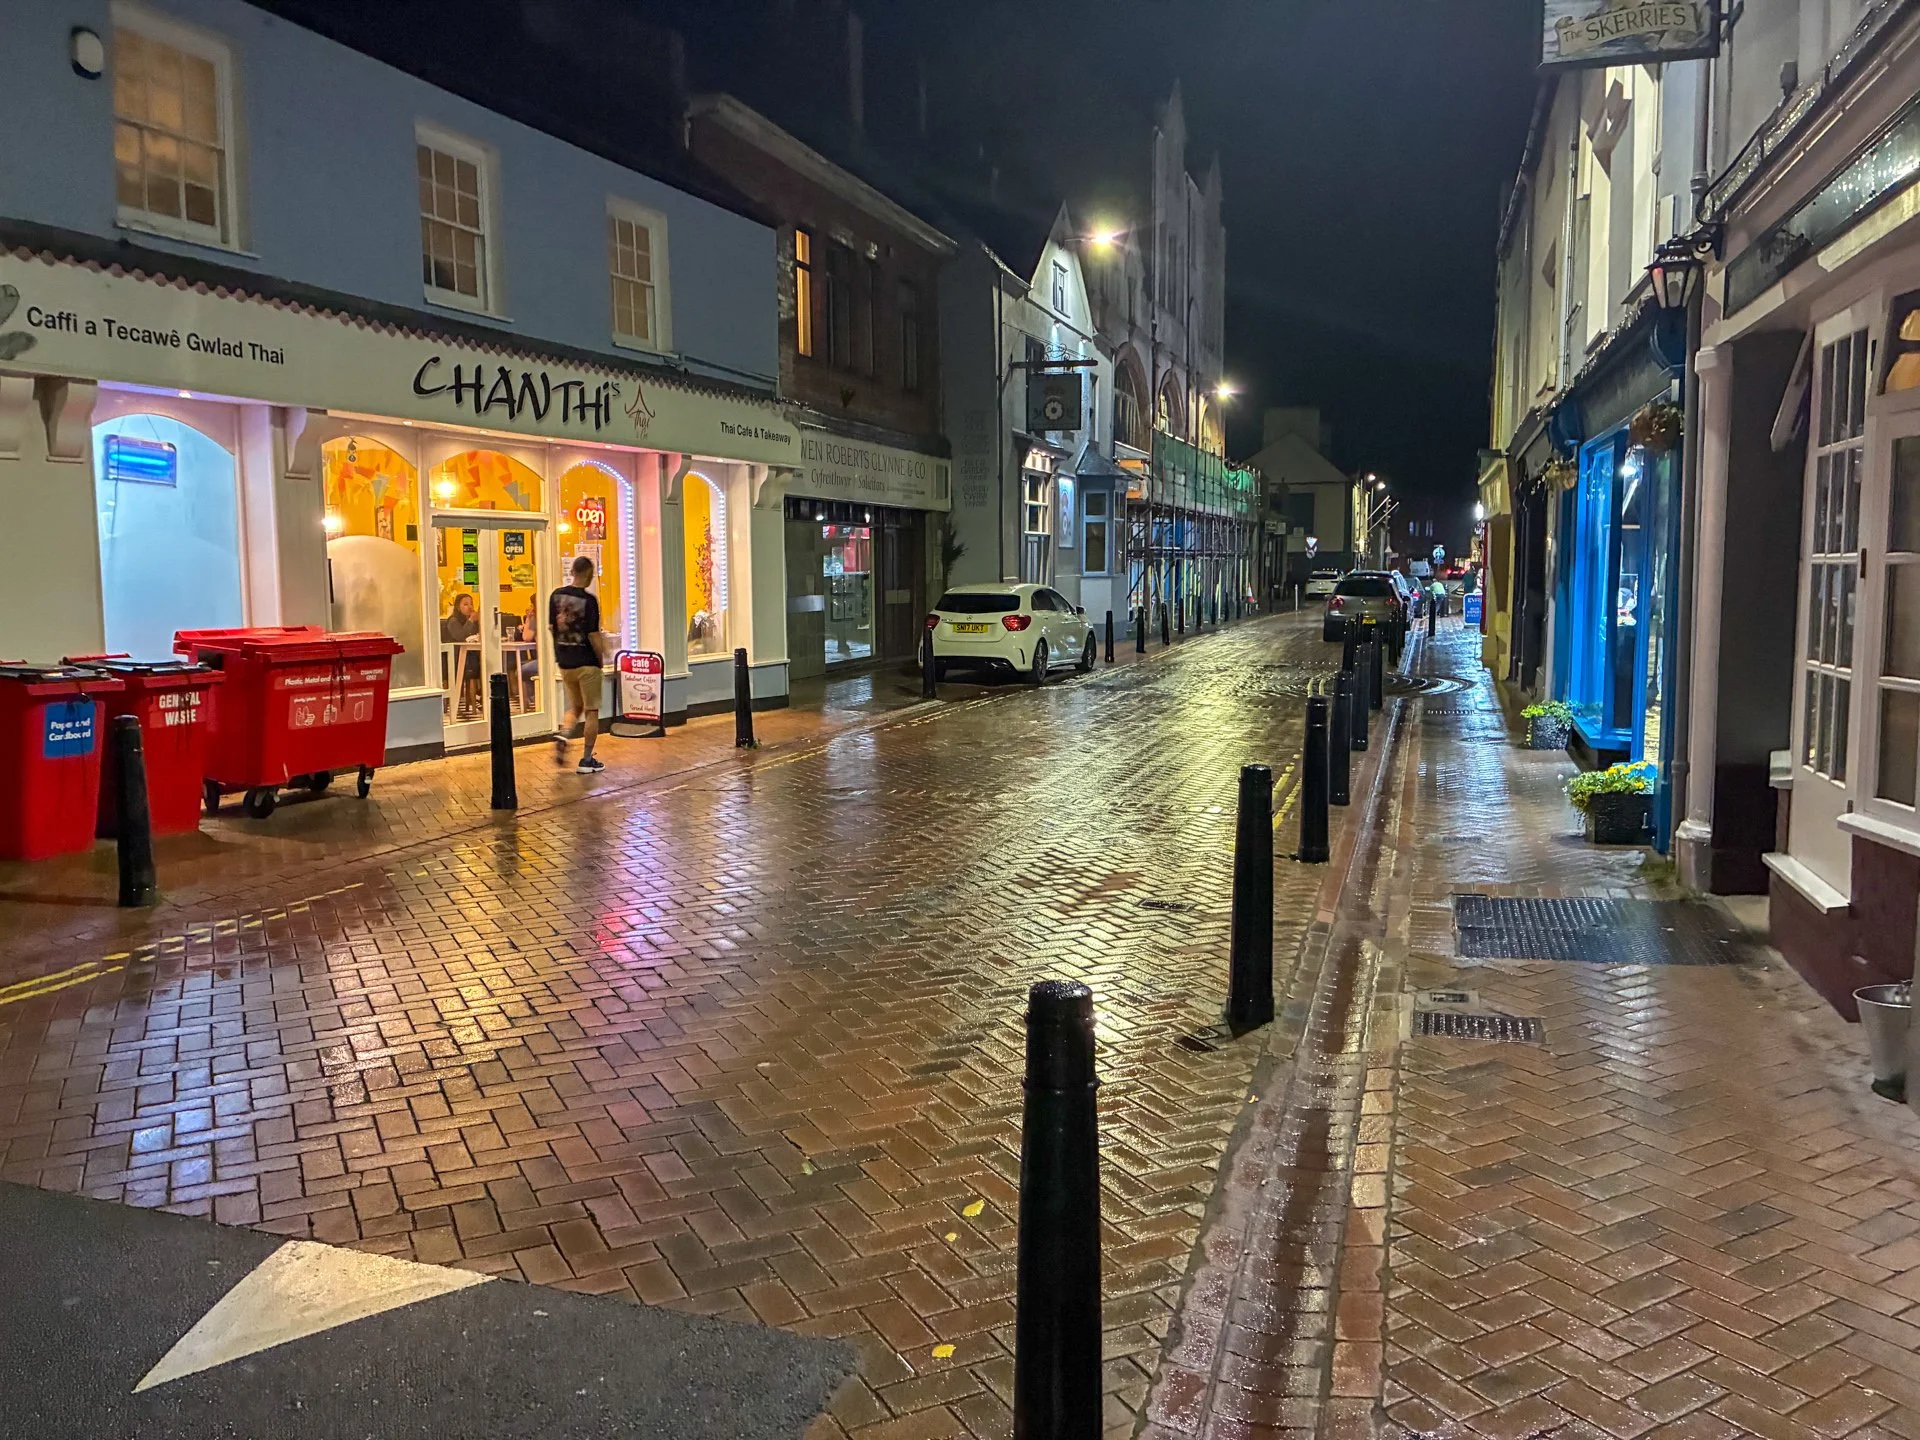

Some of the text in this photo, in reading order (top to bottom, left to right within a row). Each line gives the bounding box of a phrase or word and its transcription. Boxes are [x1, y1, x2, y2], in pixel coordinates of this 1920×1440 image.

[1586, 7, 1687, 41] SKERRIES
[26, 306, 285, 366] Caffi a Tecawê Gwlad Thai
[720, 421, 735, 434] Thai
[753, 426, 759, 438] &
[760, 427, 792, 445] Takeaway
[826, 443, 870, 470] ROBERTS
[871, 452, 905, 476] GLYNNE
[914, 461, 926, 479] CO
[858, 475, 885, 491] Solicitors
[576, 508, 605, 526] open
[304, 676, 320, 684] Metal
[321, 674, 331, 682] and
[159, 691, 201, 709] GENAL
